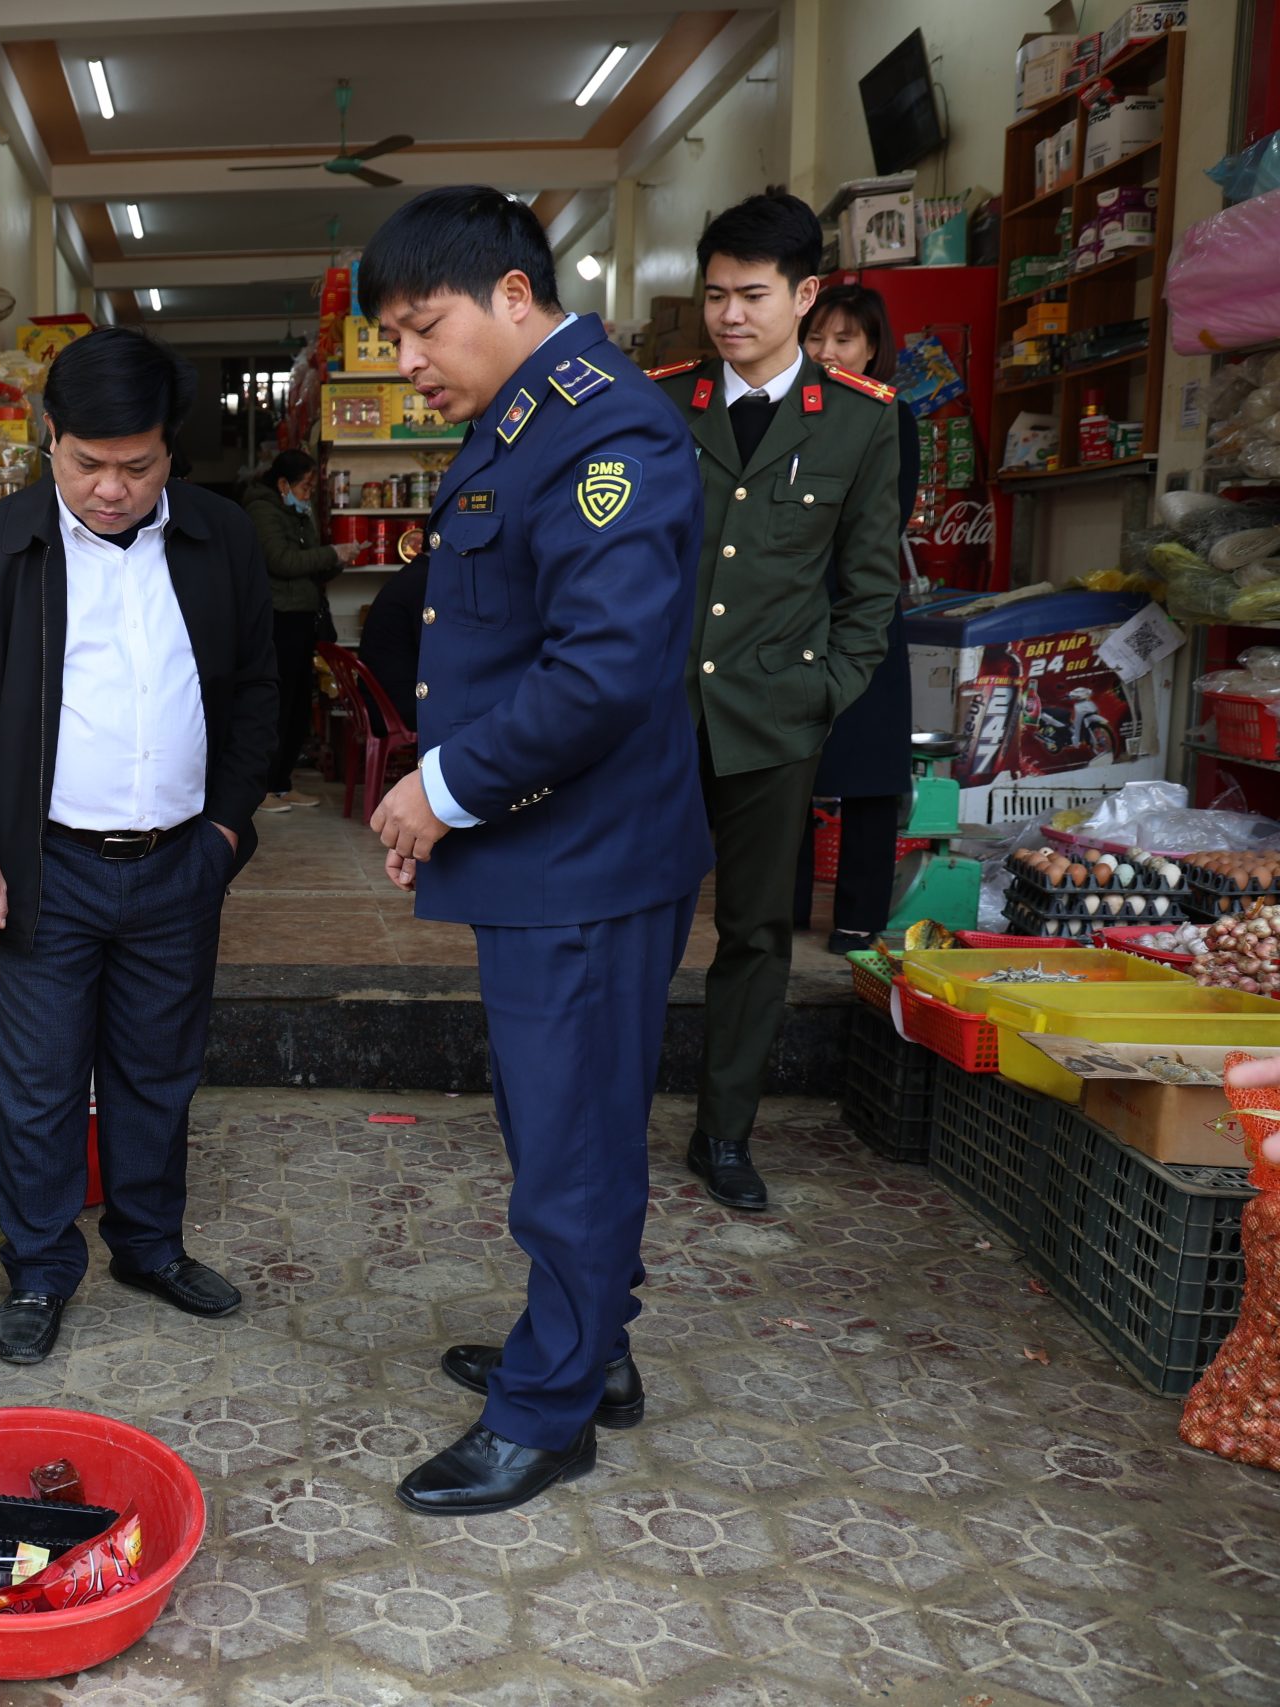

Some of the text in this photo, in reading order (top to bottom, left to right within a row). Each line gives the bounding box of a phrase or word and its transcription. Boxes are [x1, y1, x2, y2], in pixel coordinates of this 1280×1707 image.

[588, 462, 625, 475] DMS
[934, 501, 993, 545] Cola
[1029, 655, 1064, 677] 24
